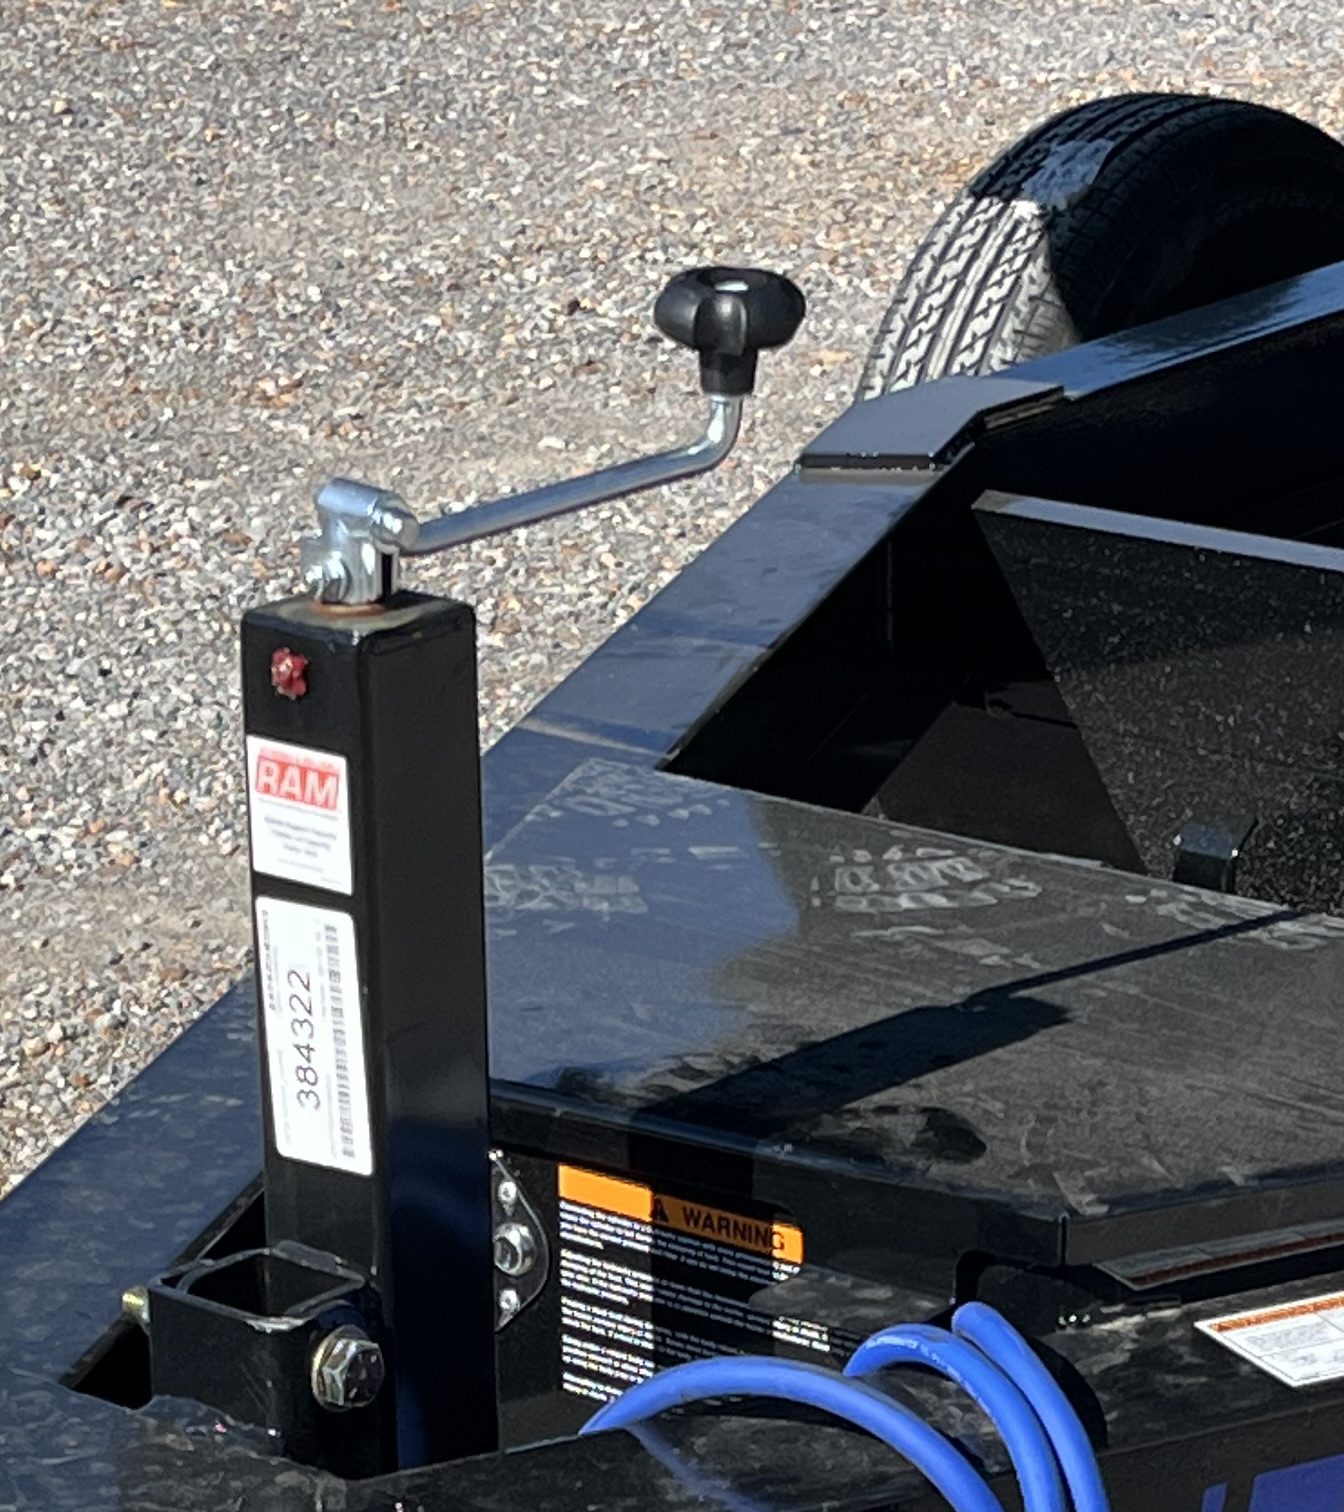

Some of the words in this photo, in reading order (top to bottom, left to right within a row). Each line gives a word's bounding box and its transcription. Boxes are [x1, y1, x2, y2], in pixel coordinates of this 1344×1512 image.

[257, 757, 339, 810] RAM
[286, 968, 321, 1112] 384322
[681, 1206, 787, 1251] WARNING
